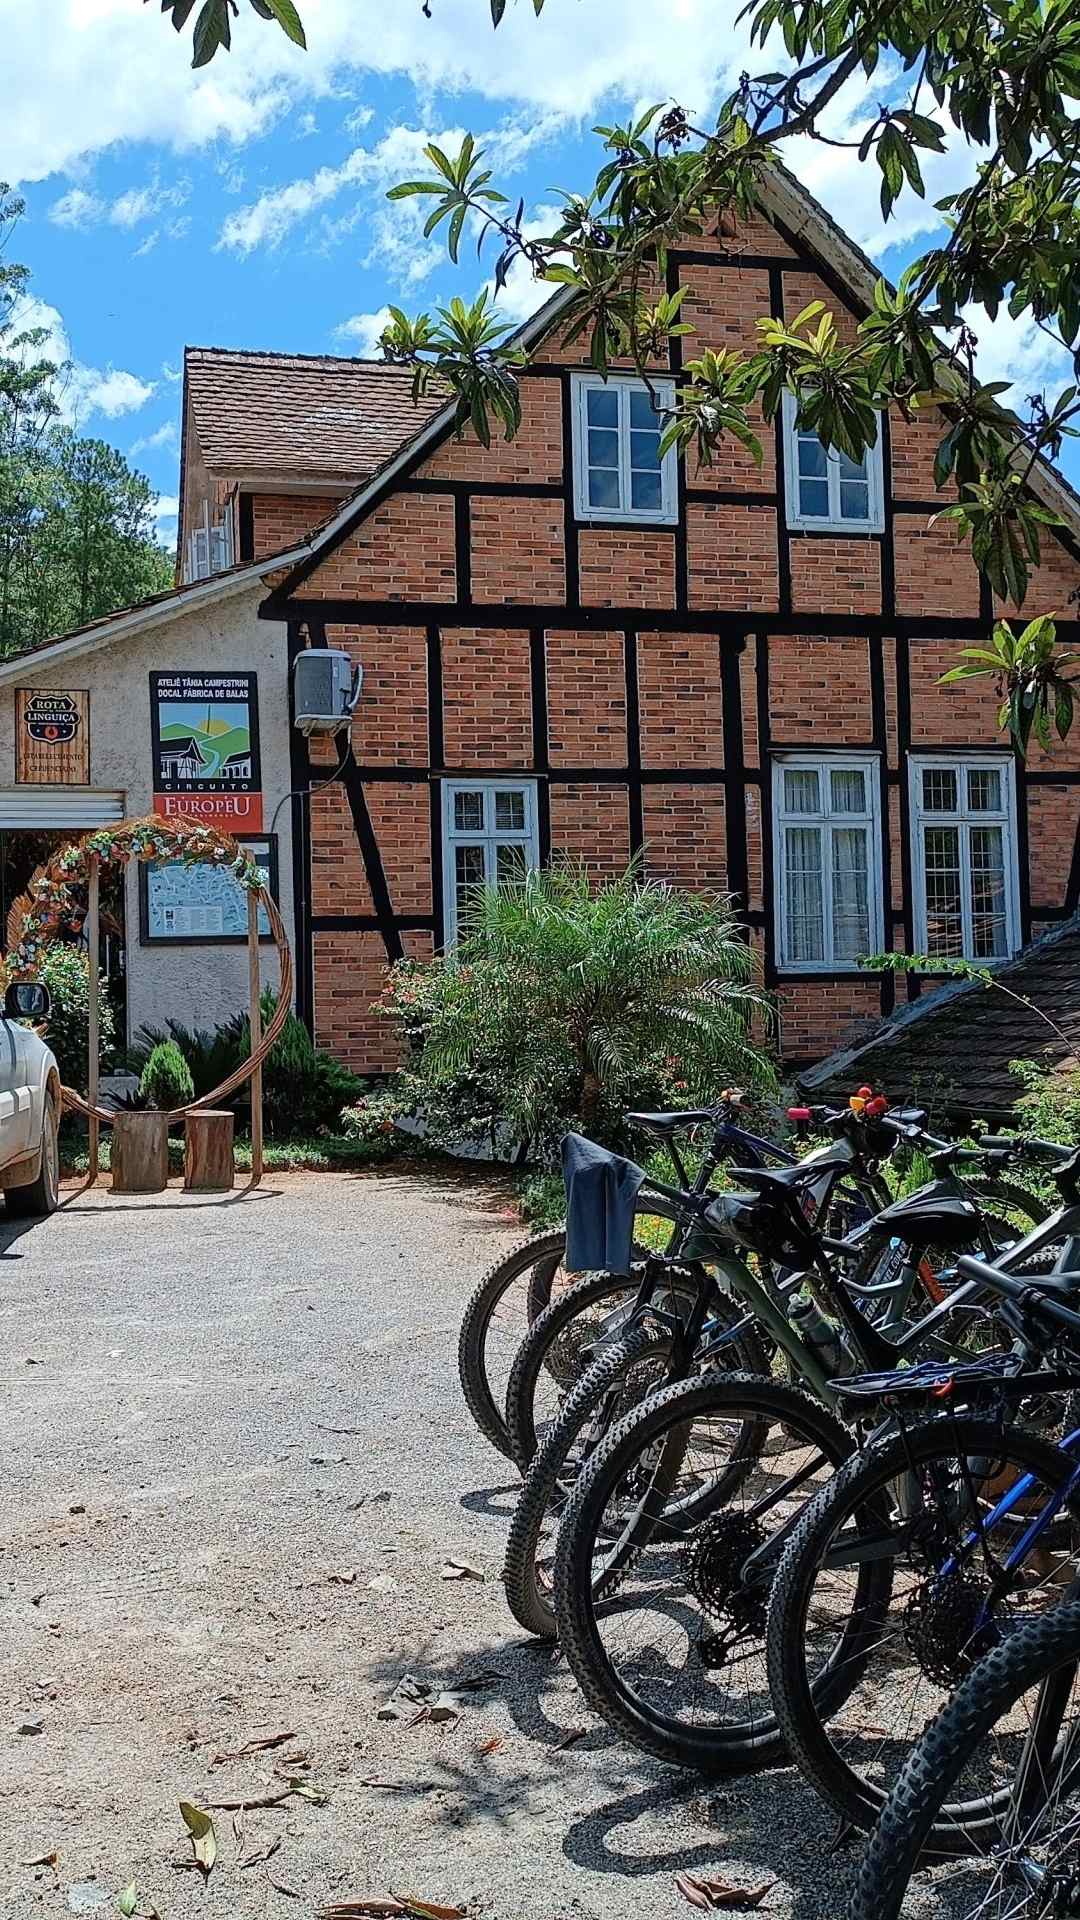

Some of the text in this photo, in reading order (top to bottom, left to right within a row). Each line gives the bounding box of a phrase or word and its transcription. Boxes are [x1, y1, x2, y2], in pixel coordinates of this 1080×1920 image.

[157, 677, 181, 687] ATELIÊ
[204, 679, 249, 688] CAMPESTRINI
[158, 688, 249, 698] DOCAL FÁBRICA DE BALAS
[36, 701, 66, 709] ROTA
[27, 713, 75, 722] LINGUIÇA
